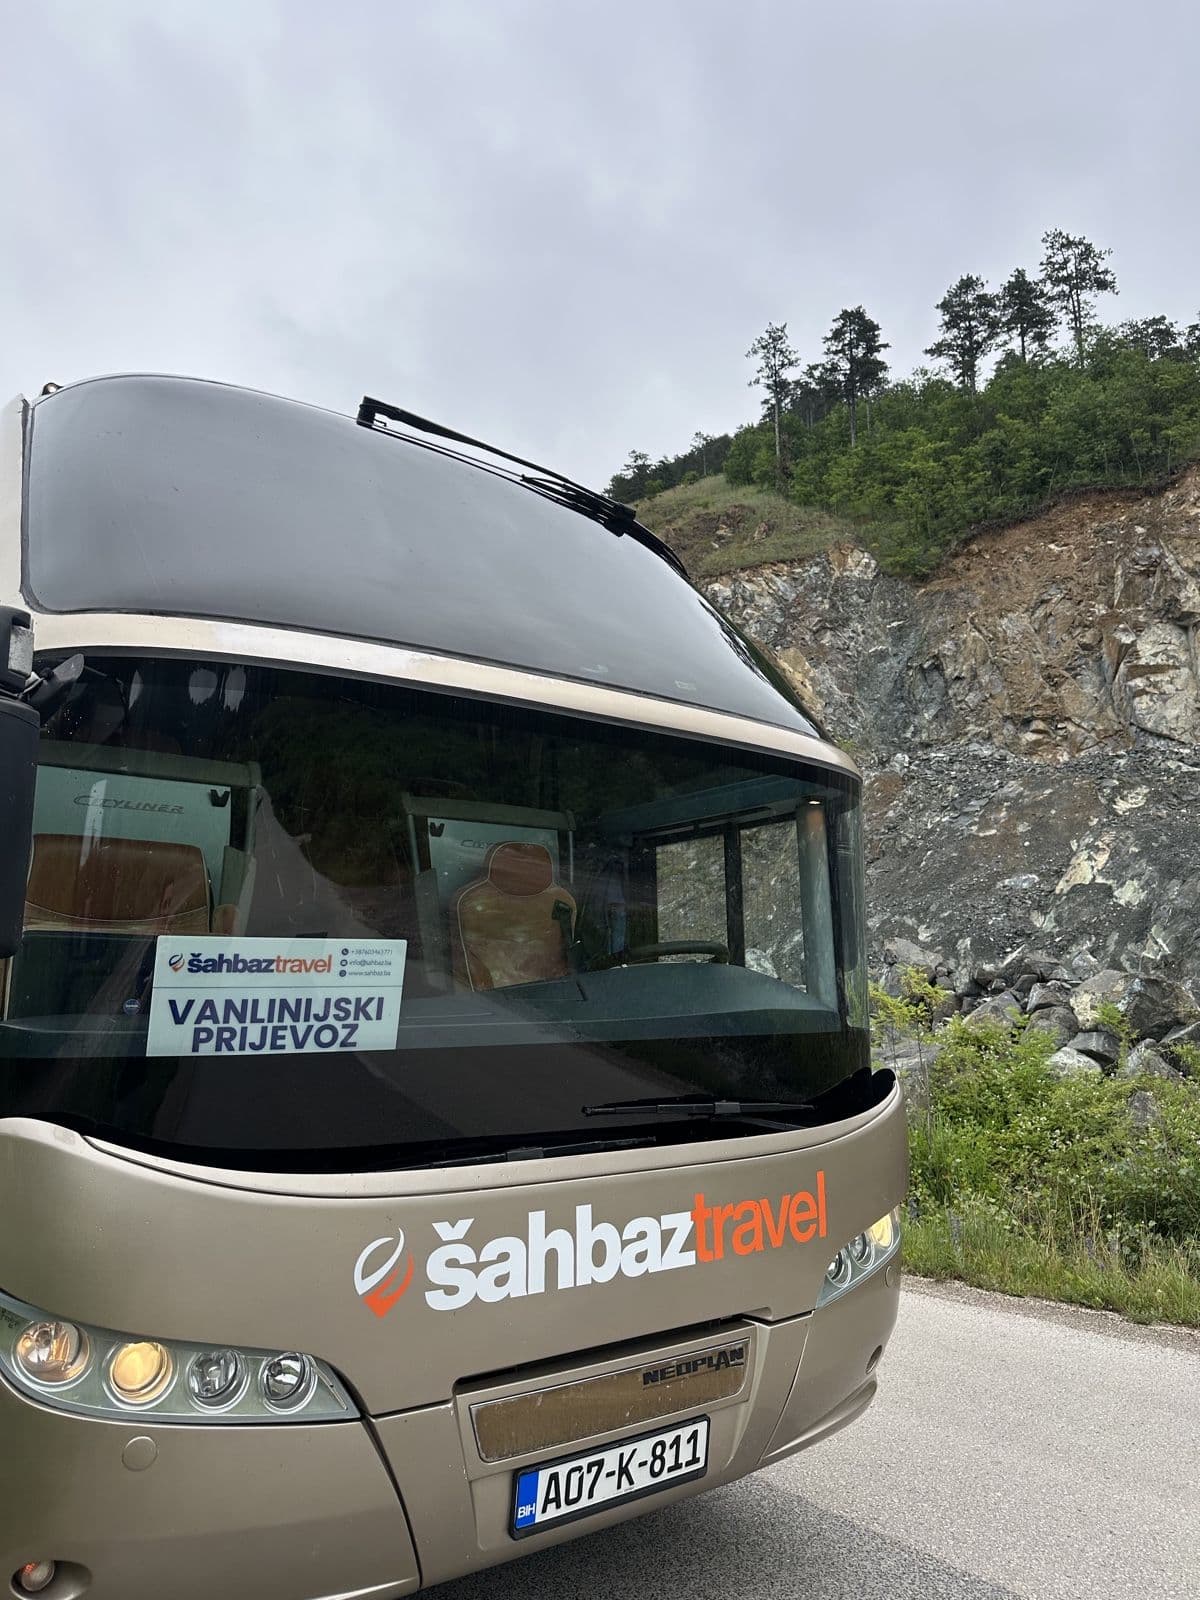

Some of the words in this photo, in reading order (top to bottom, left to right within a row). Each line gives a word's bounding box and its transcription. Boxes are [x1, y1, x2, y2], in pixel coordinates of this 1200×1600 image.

[74, 795, 184, 814] CTYLINER
[187, 952, 332, 973] šahbaztravel
[168, 997, 385, 1025] VANLINIJSKI
[191, 1023, 359, 1053] PRIJEVOZ
[425, 1170, 827, 1311] šahbaztravel
[643, 1347, 745, 1386] NEOPLAN
[541, 1429, 701, 1514] A07-K-811
[517, 1502, 536, 1519] BIH
